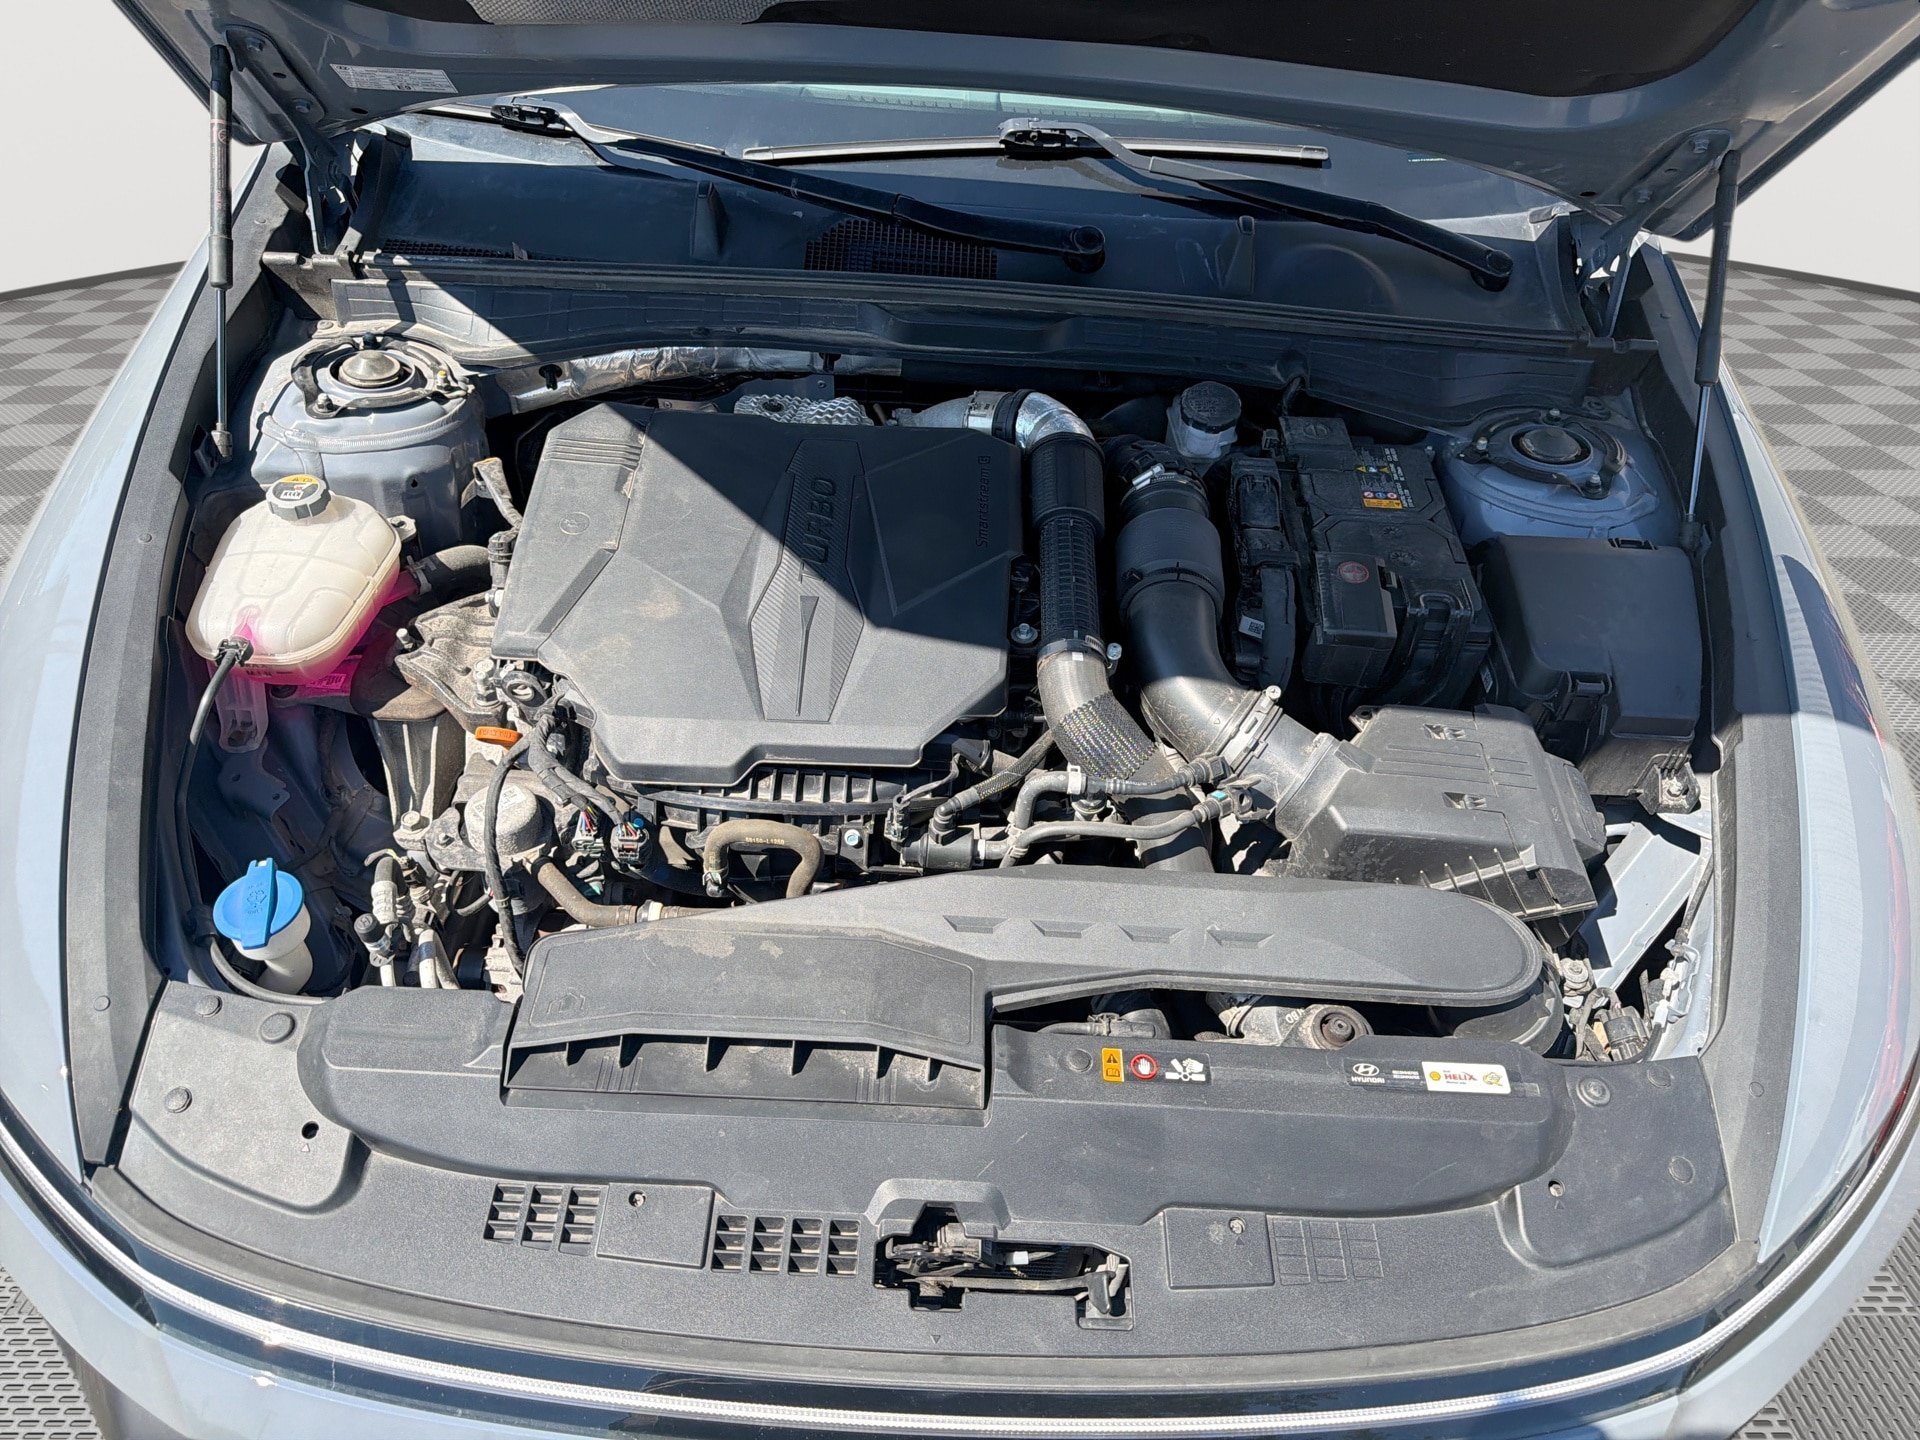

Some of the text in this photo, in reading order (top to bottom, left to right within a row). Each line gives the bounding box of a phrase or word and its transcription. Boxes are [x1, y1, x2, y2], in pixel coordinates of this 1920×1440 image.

[798, 478, 837, 583] TURBO
[976, 467, 991, 548] Smartstream
[1351, 1076, 1386, 1084] HYUNDAI
[1444, 1071, 1478, 1082] HELIX
